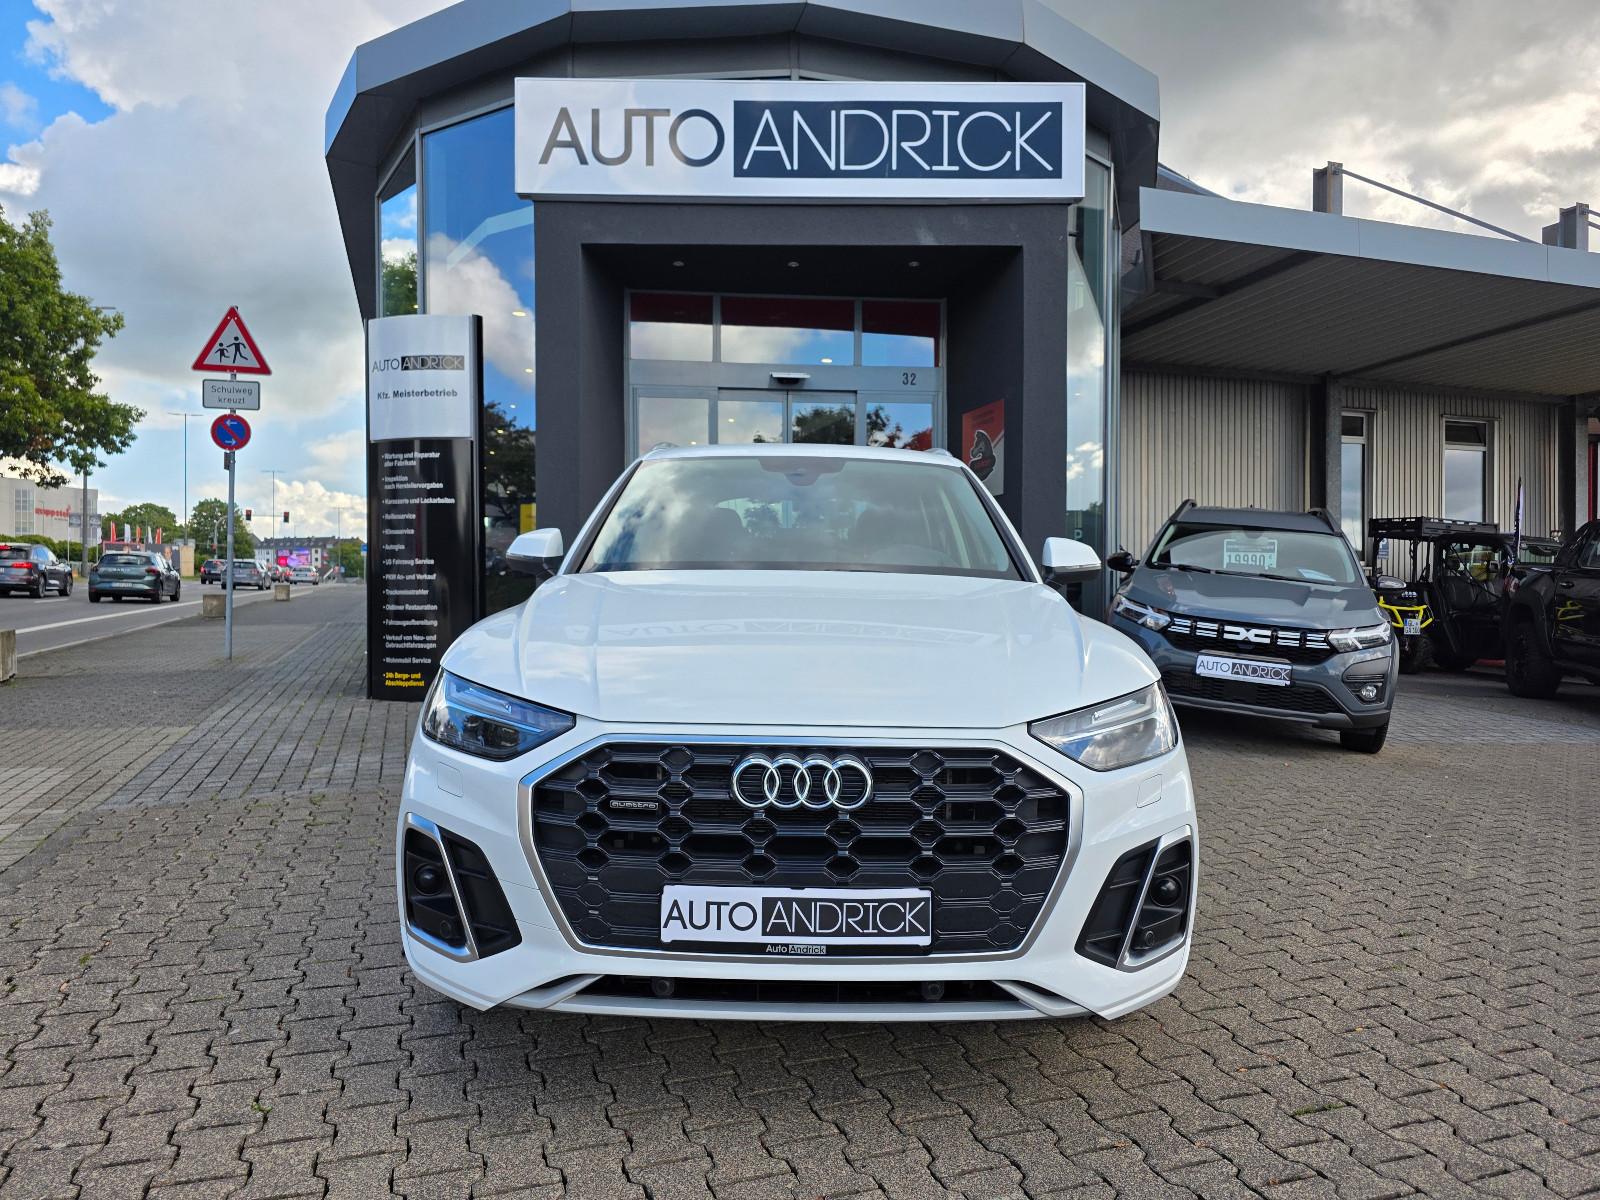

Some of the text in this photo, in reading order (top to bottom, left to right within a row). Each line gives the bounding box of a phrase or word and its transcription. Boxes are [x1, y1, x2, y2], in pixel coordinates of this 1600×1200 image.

[538, 107, 1053, 171] AUTO ANDRICK
[372, 356, 463, 373] AUTO ANDRICK
[902, 372, 917, 386] 32
[211, 385, 253, 397] Schulweg
[377, 389, 458, 400] Kfz. Meisterbetrieb
[218, 395, 245, 405] kreuzt
[1198, 660, 1290, 680] AUTO ANDRICK
[611, 801, 656, 809] quattro
[662, 899, 926, 933] AUTO ANDRICK
[766, 944, 825, 954] Auto Andrick
